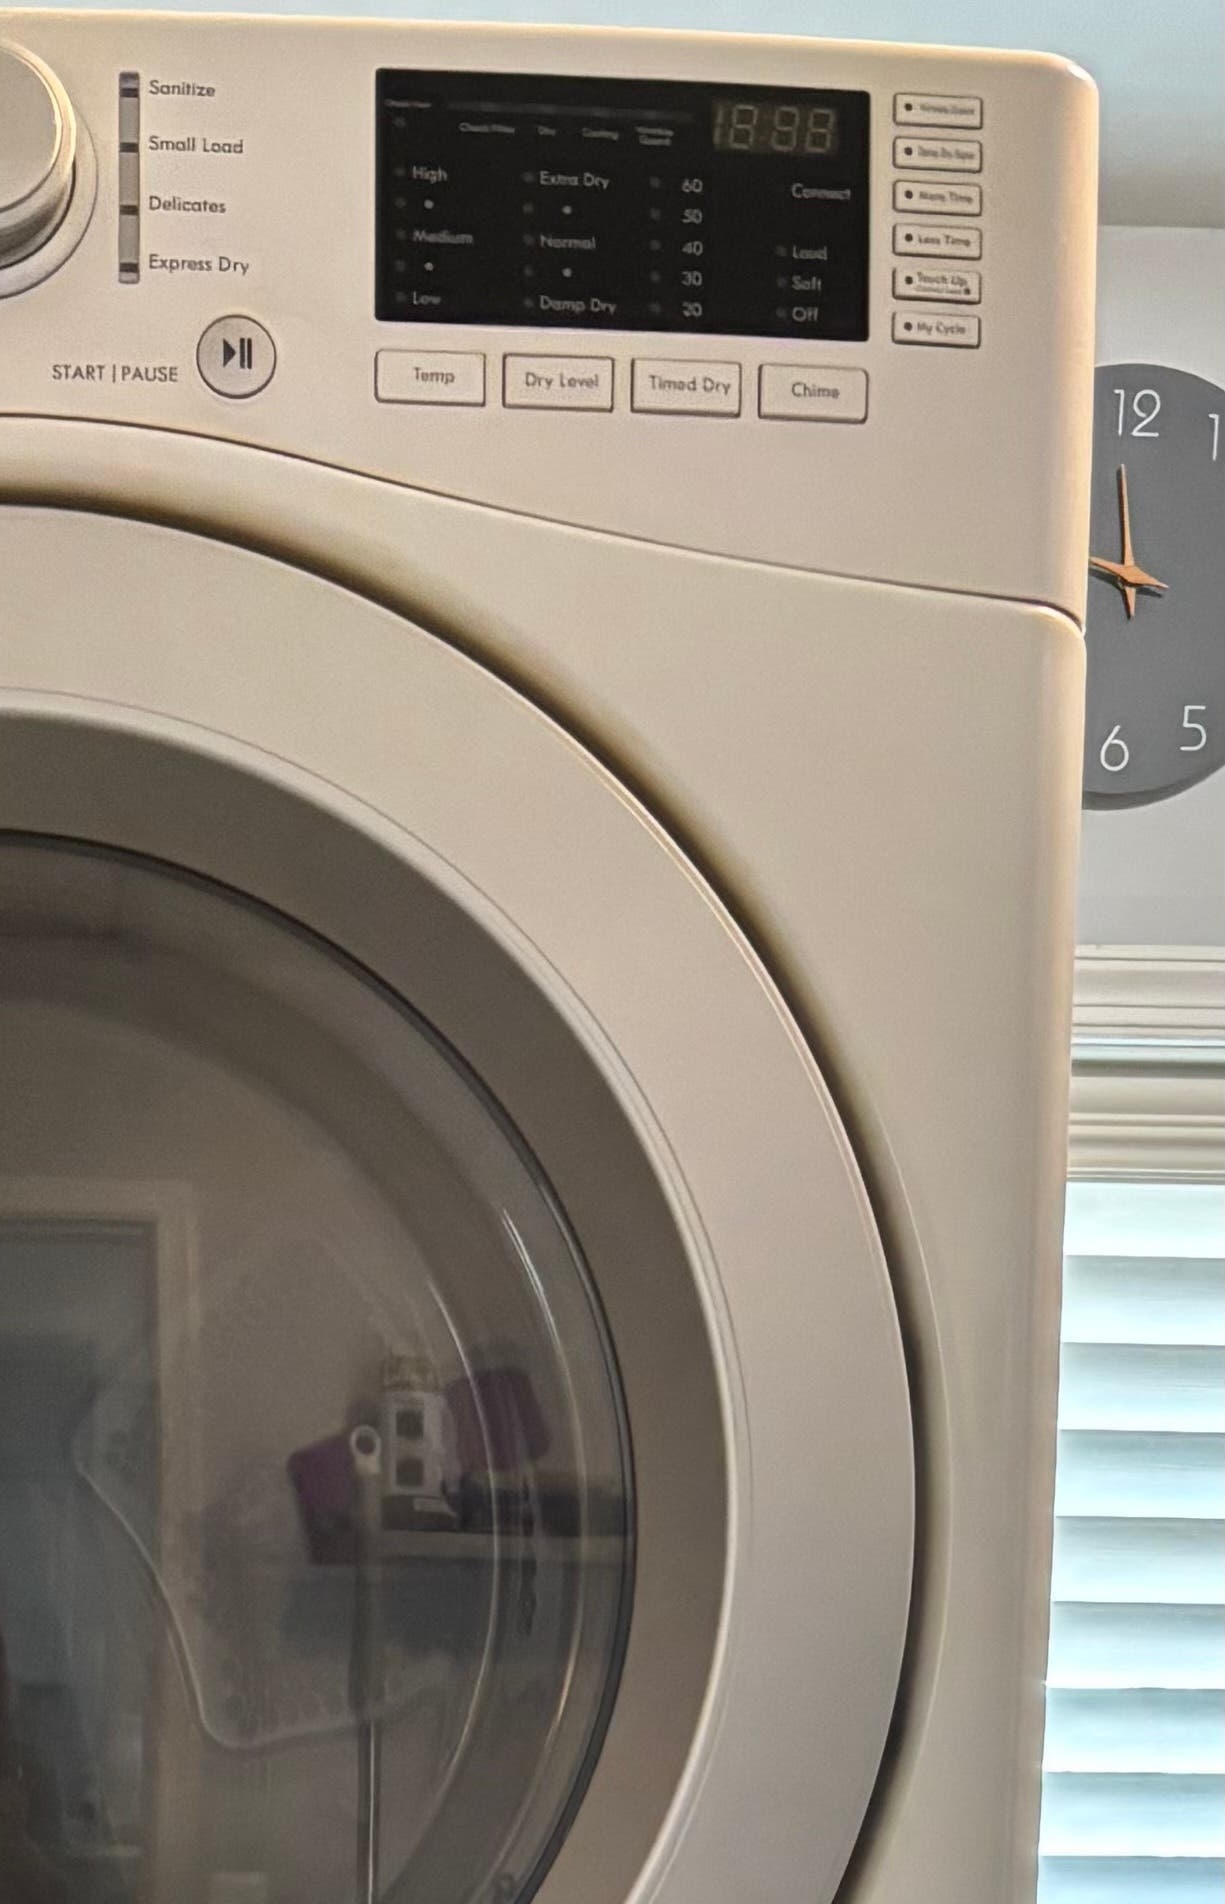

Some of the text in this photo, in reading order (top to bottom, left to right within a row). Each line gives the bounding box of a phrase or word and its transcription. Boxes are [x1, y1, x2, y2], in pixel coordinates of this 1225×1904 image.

[149, 80, 215, 96] Sanitize
[149, 136, 243, 153] Small Load
[413, 166, 447, 184] High
[540, 171, 609, 189] Extra Dry
[682, 179, 703, 192] 60
[149, 196, 226, 213] Delicates
[682, 209, 702, 224] 50
[413, 230, 473, 243] Medium
[540, 235, 596, 249] Normal
[683, 241, 703, 256] 40
[793, 246, 827, 260] Loud
[149, 254, 249, 275] Express Dry
[682, 271, 702, 286] 30
[792, 276, 821, 290] Soft
[413, 291, 441, 305] Low
[540, 295, 616, 314] Damp Dry
[792, 307, 818, 321] Off
[53, 364, 104, 380] START
[122, 366, 177, 382] PAUSE
[414, 367, 455, 384] Temp
[525, 372, 598, 393] Dry Level
[649, 375, 731, 395] Timed Dry
[792, 382, 840, 399] Chime
[1114, 390, 1160, 437] 12
[1209, 414, 1219, 460] 1
[1180, 705, 1206, 750] 5
[1101, 725, 1129, 771] 6
